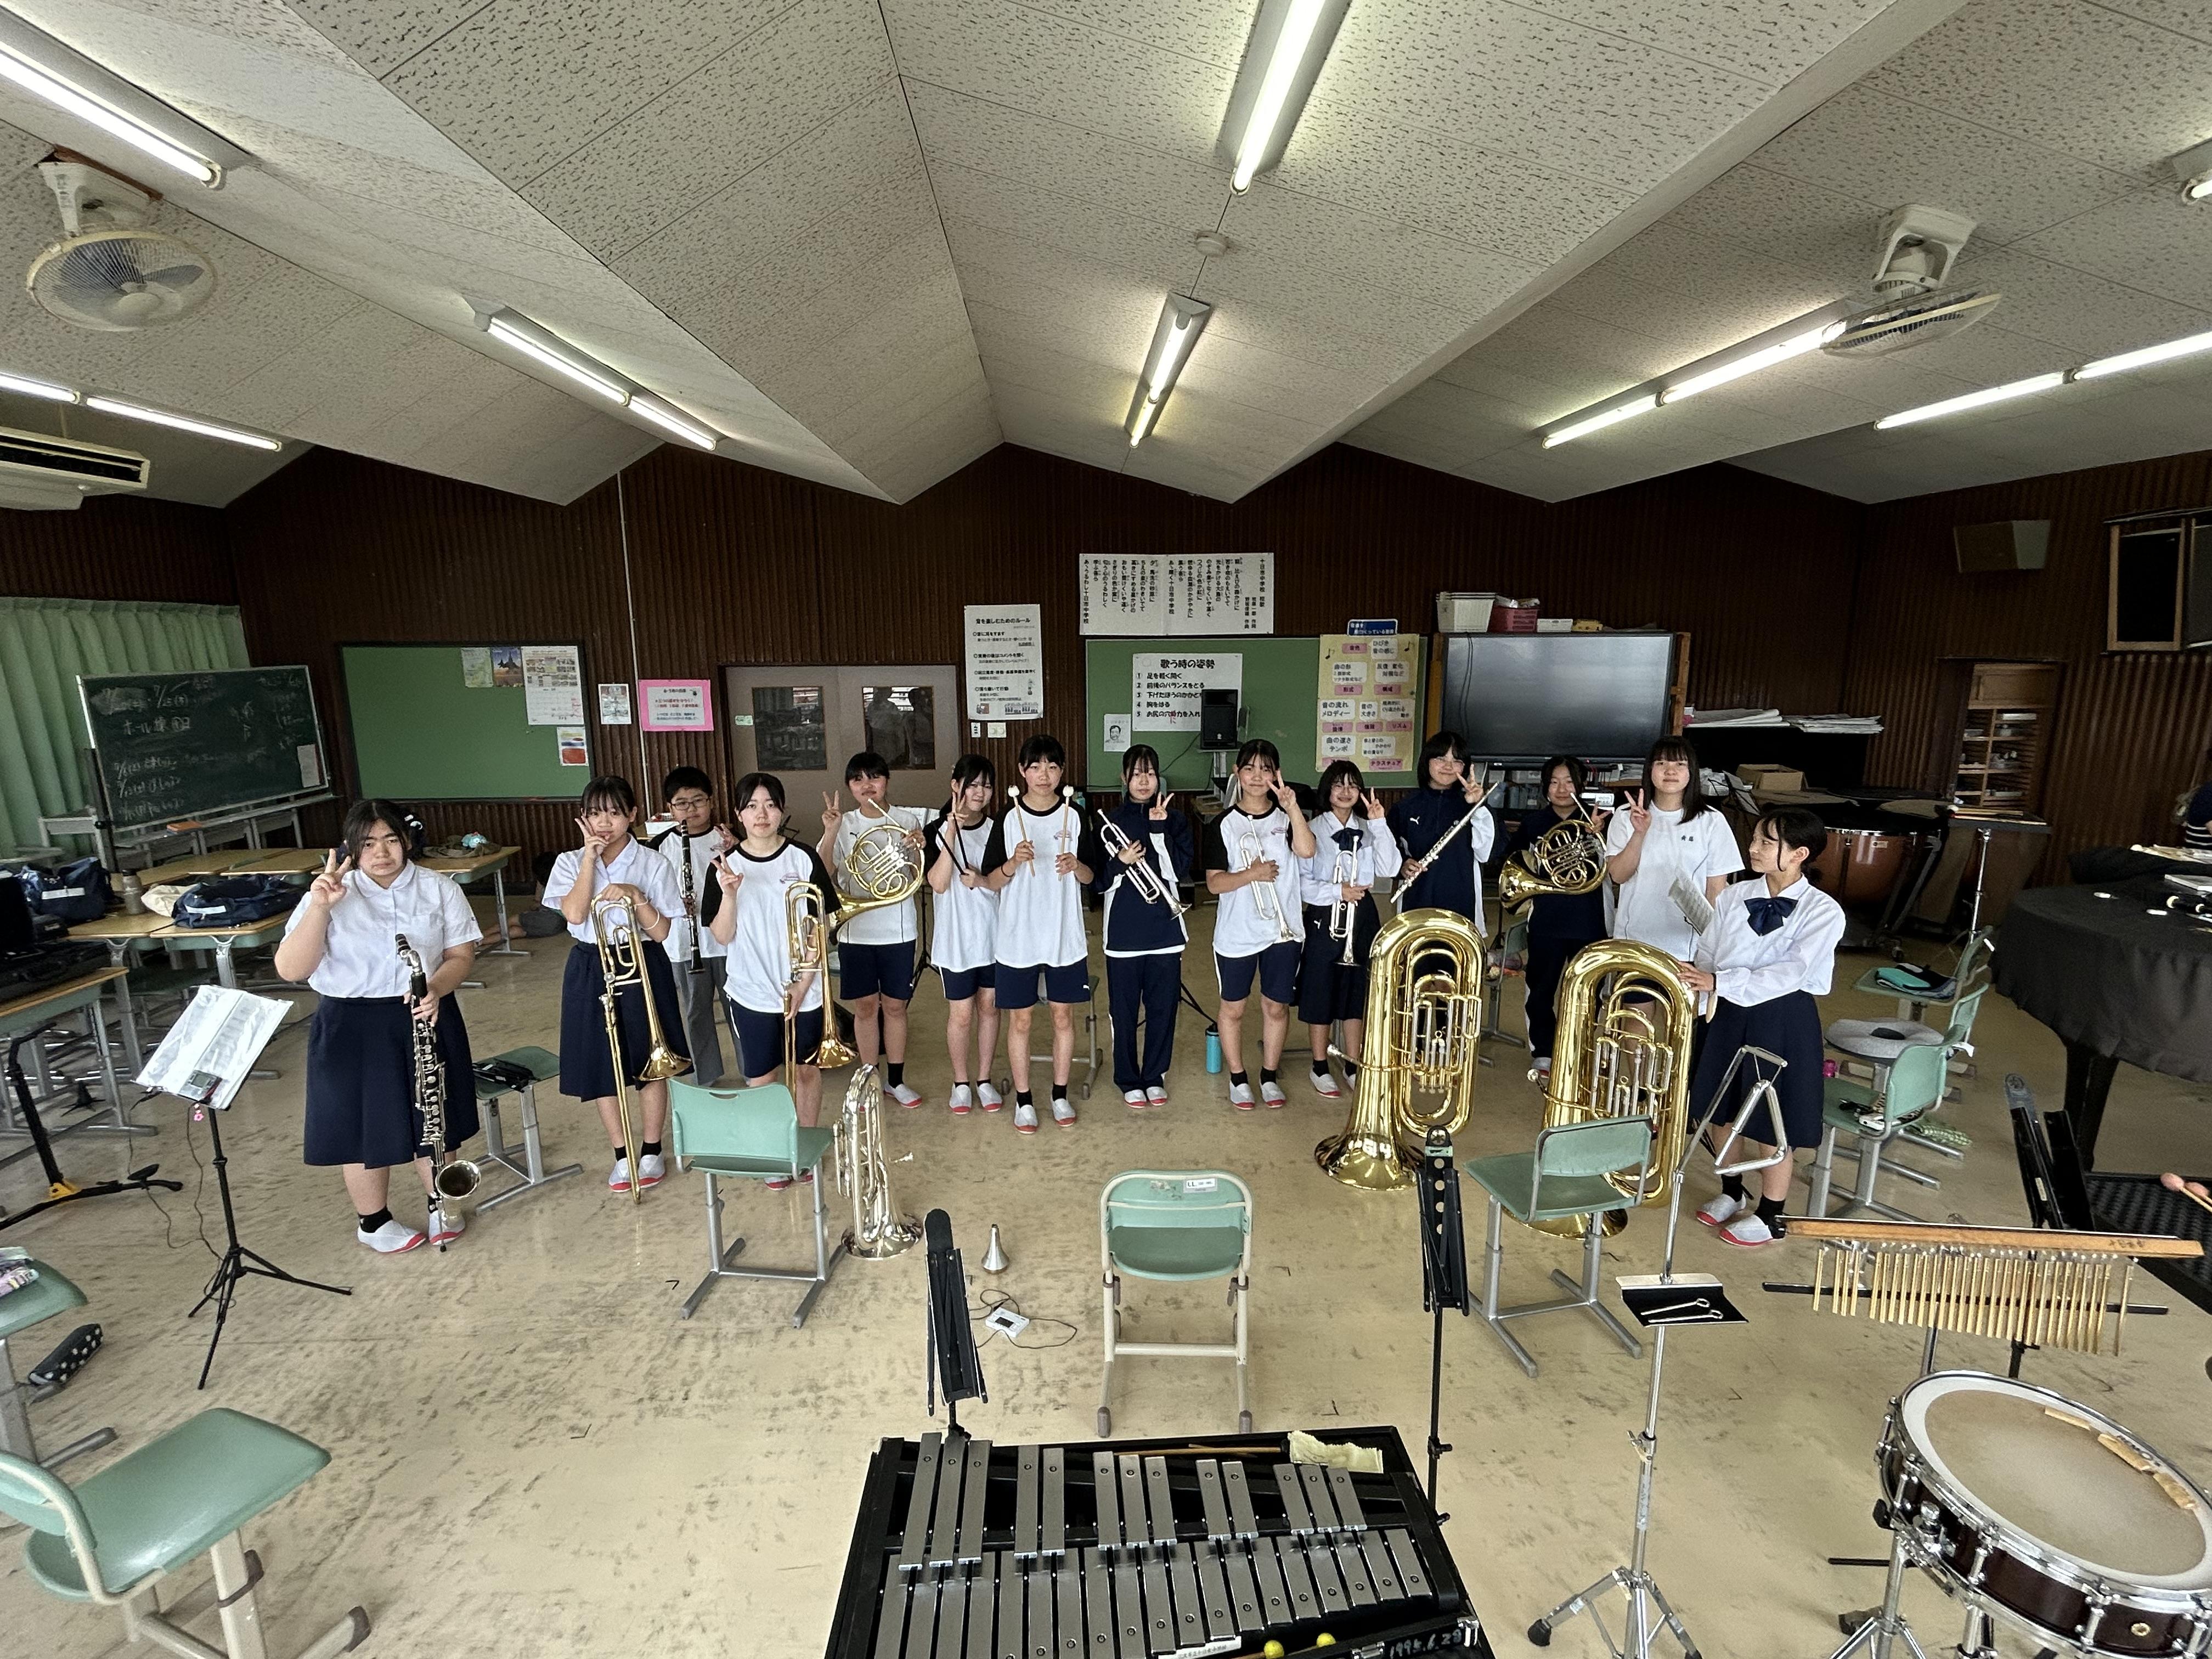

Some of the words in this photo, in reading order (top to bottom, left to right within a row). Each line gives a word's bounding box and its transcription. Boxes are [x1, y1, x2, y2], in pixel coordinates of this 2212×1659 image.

[1160, 659, 1215, 669] 歌う時の姿勢
